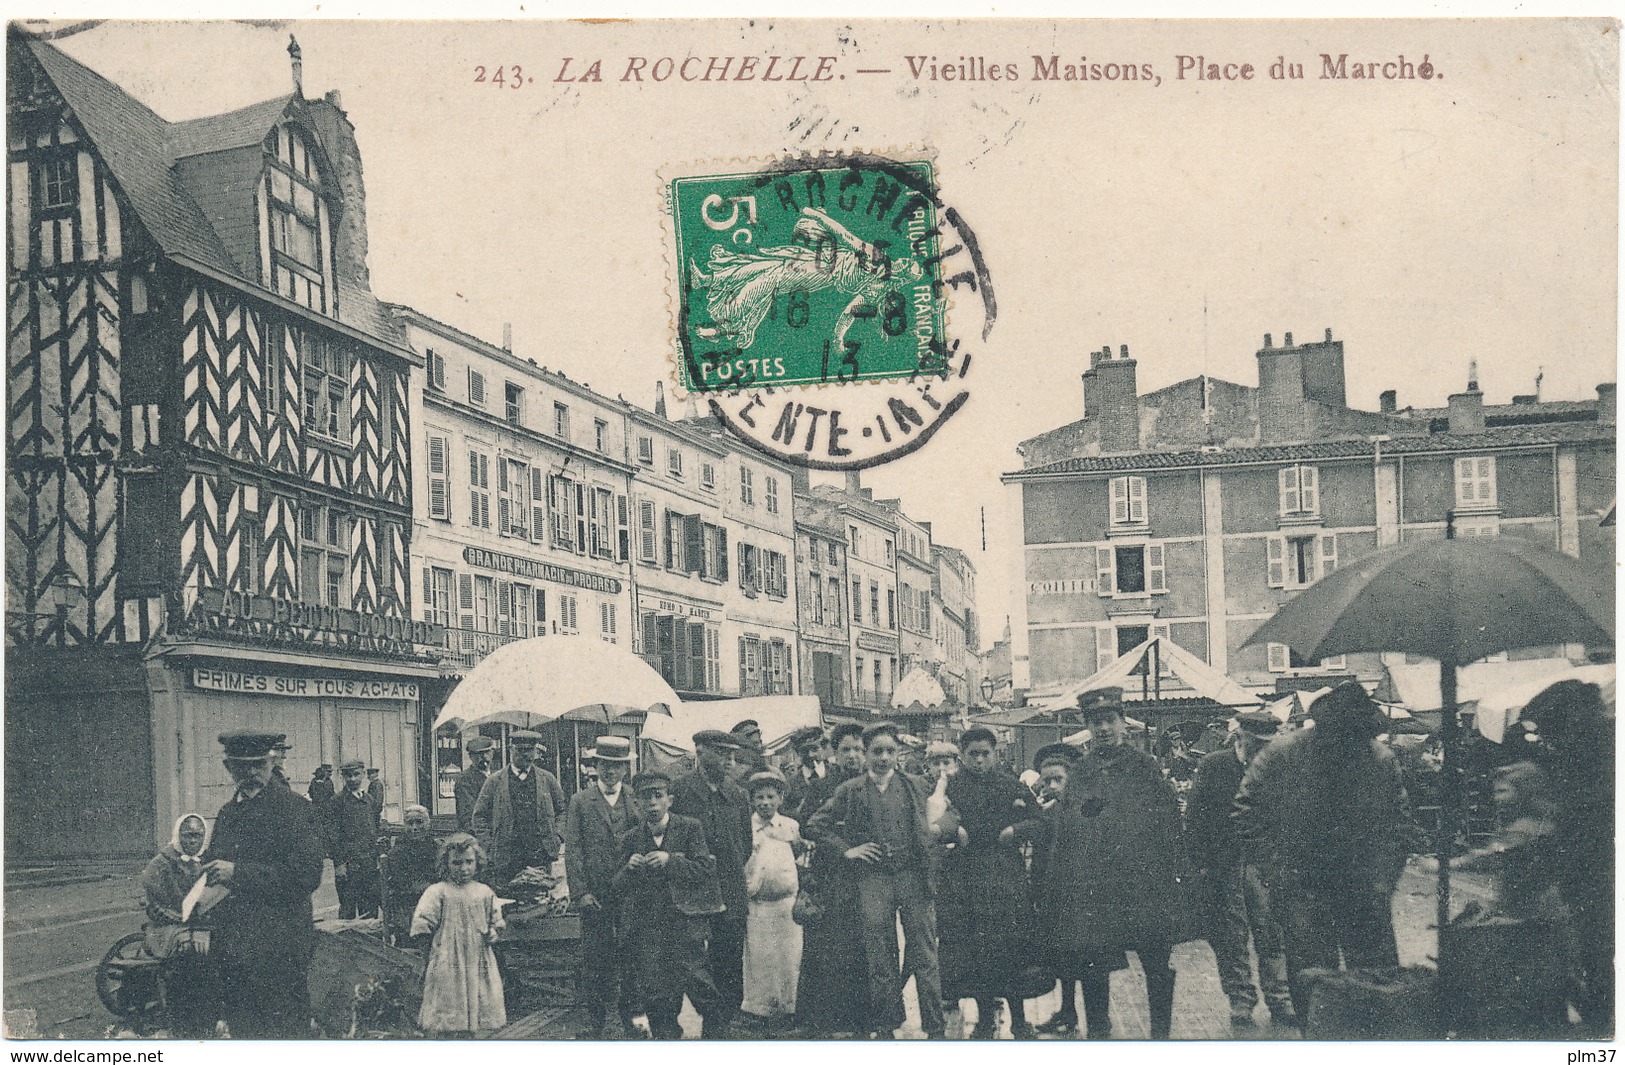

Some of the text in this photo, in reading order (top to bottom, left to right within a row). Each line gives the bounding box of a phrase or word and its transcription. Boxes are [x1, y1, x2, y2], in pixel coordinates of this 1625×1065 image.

[701, 357, 786, 381] POSTES
[219, 589, 256, 620] AU
[197, 670, 417, 698] PRIMES SUR TOUS ACHATS
